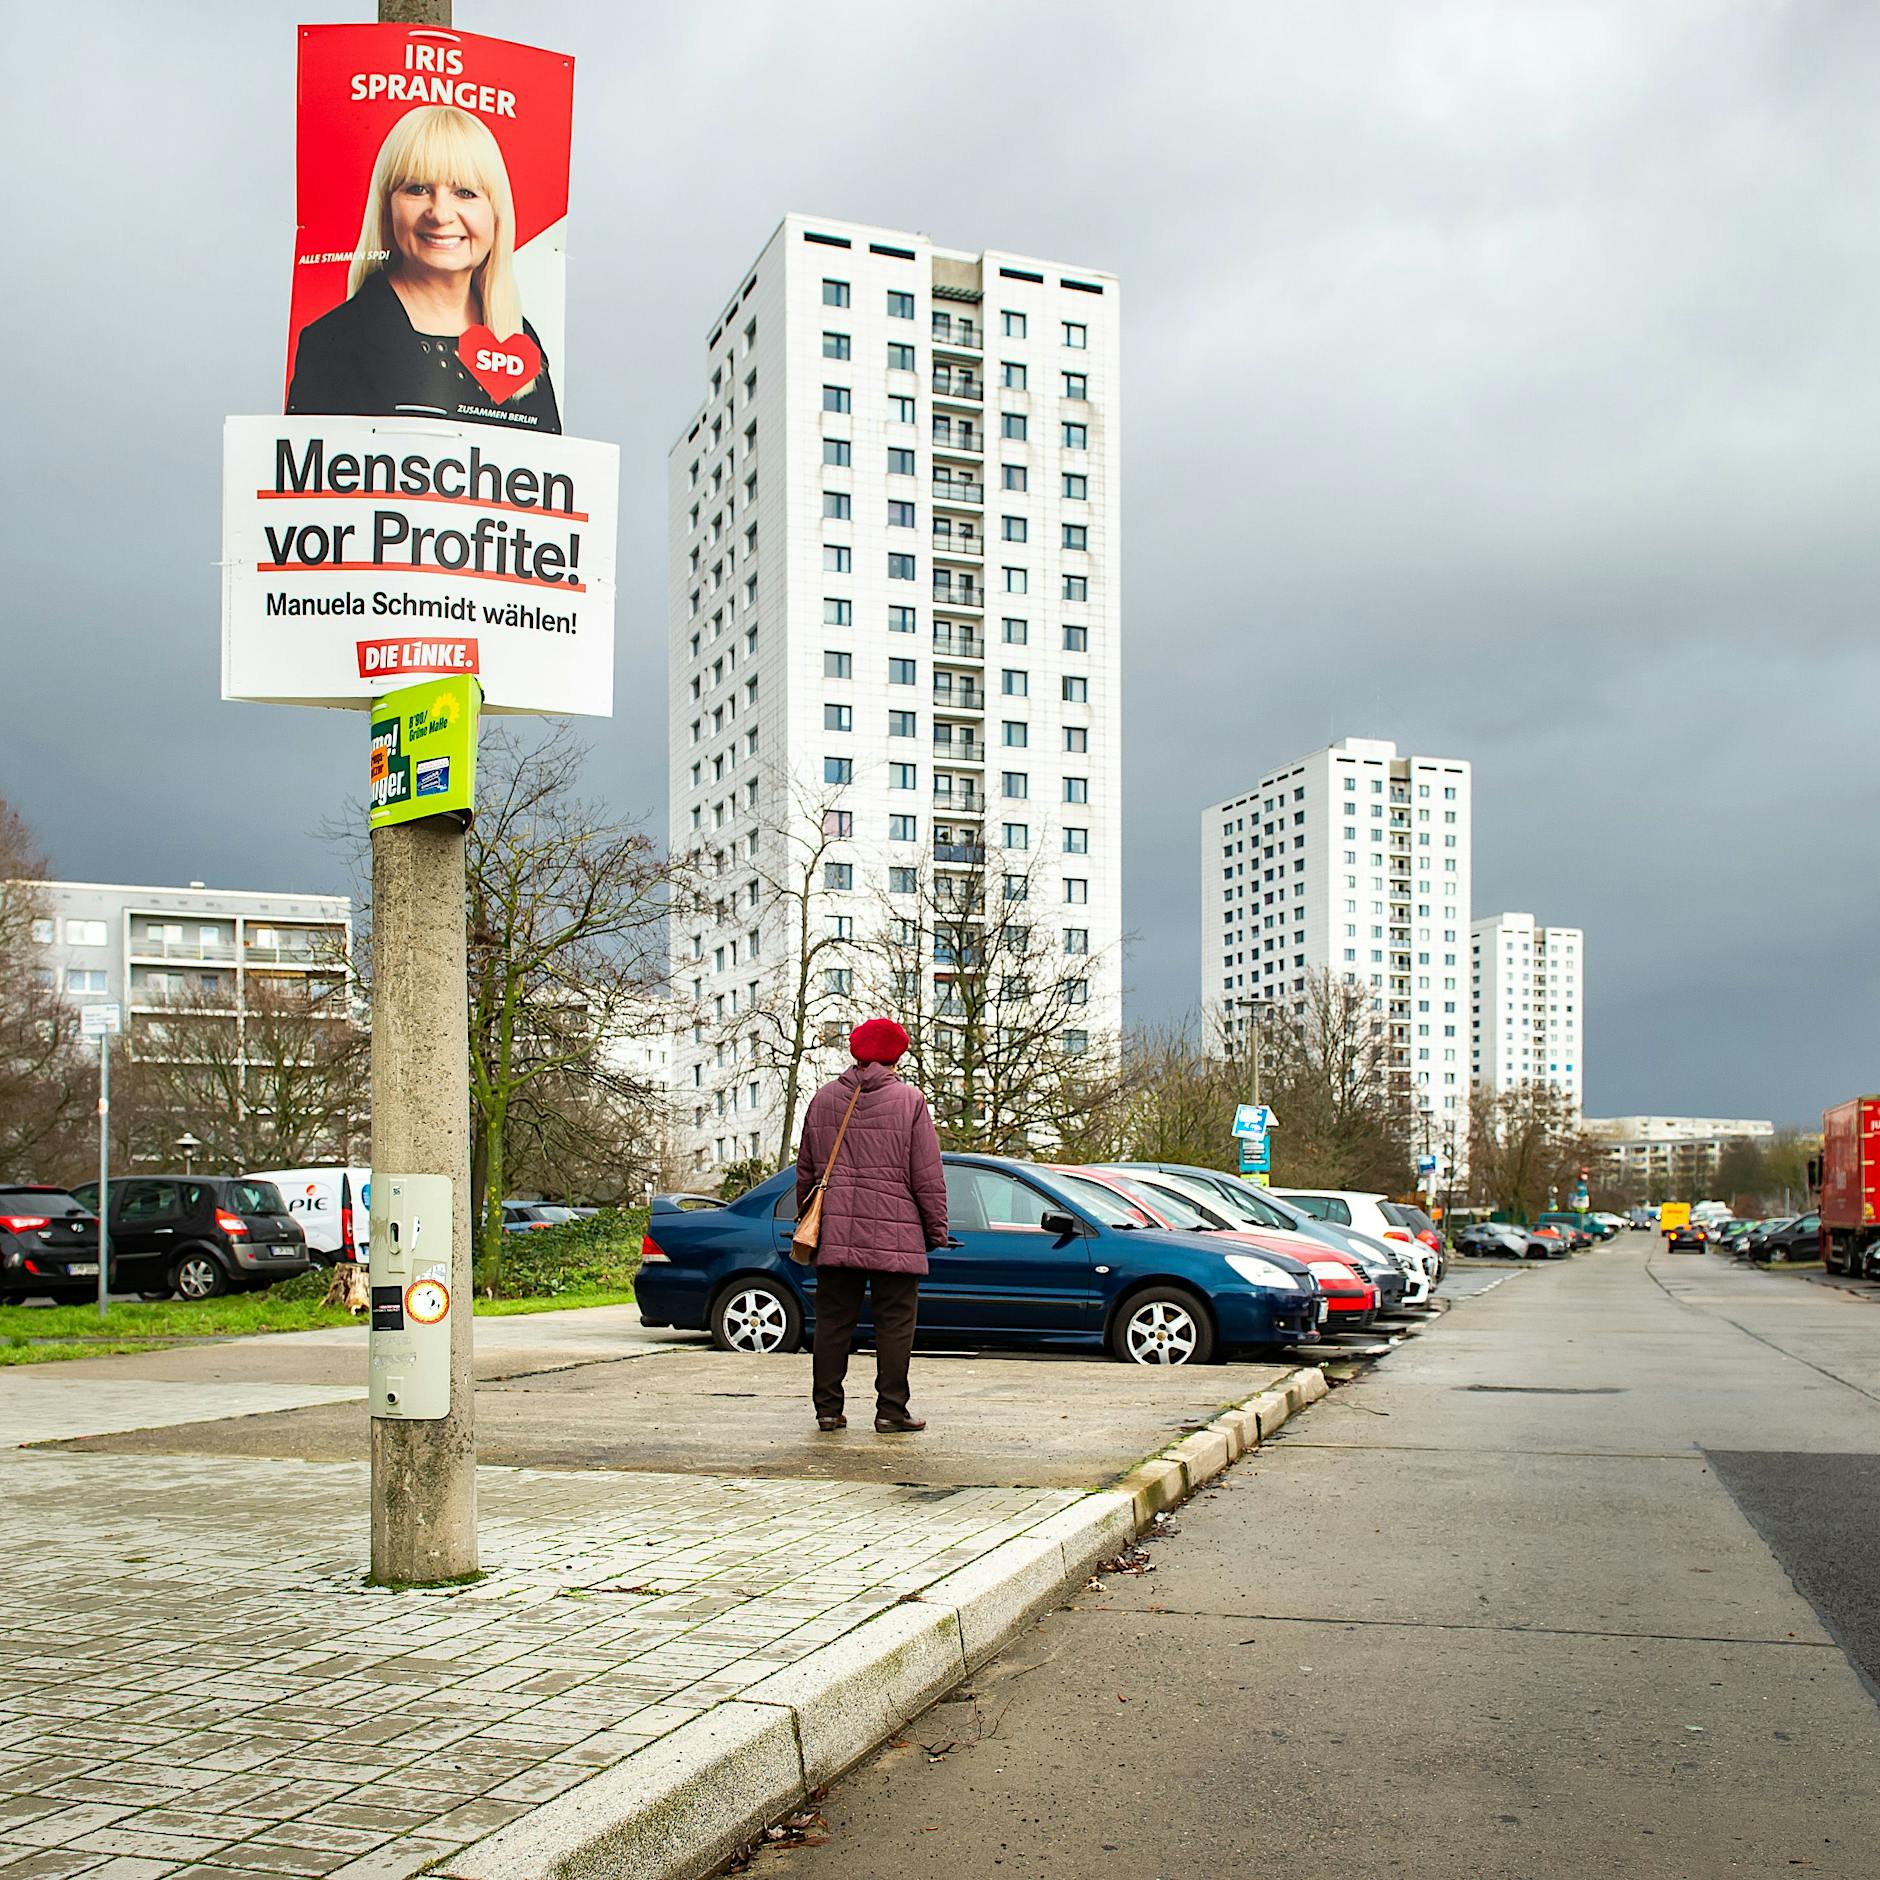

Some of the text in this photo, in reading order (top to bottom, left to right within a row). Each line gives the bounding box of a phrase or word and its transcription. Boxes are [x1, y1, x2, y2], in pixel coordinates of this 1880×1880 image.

[405, 44, 464, 75] IRIS
[351, 74, 517, 118] SPRANGER
[298, 253, 321, 265] ALLE
[366, 250, 391, 261] SPD!
[476, 349, 525, 378] SPD
[456, 404, 538, 426] ZUSAMMEN BERLIN
[275, 439, 574, 514] Menschen
[264, 510, 580, 586] vor Profite!
[266, 591, 577, 635] Manuela Schmidt wählen!
[365, 645, 399, 670] DIE
